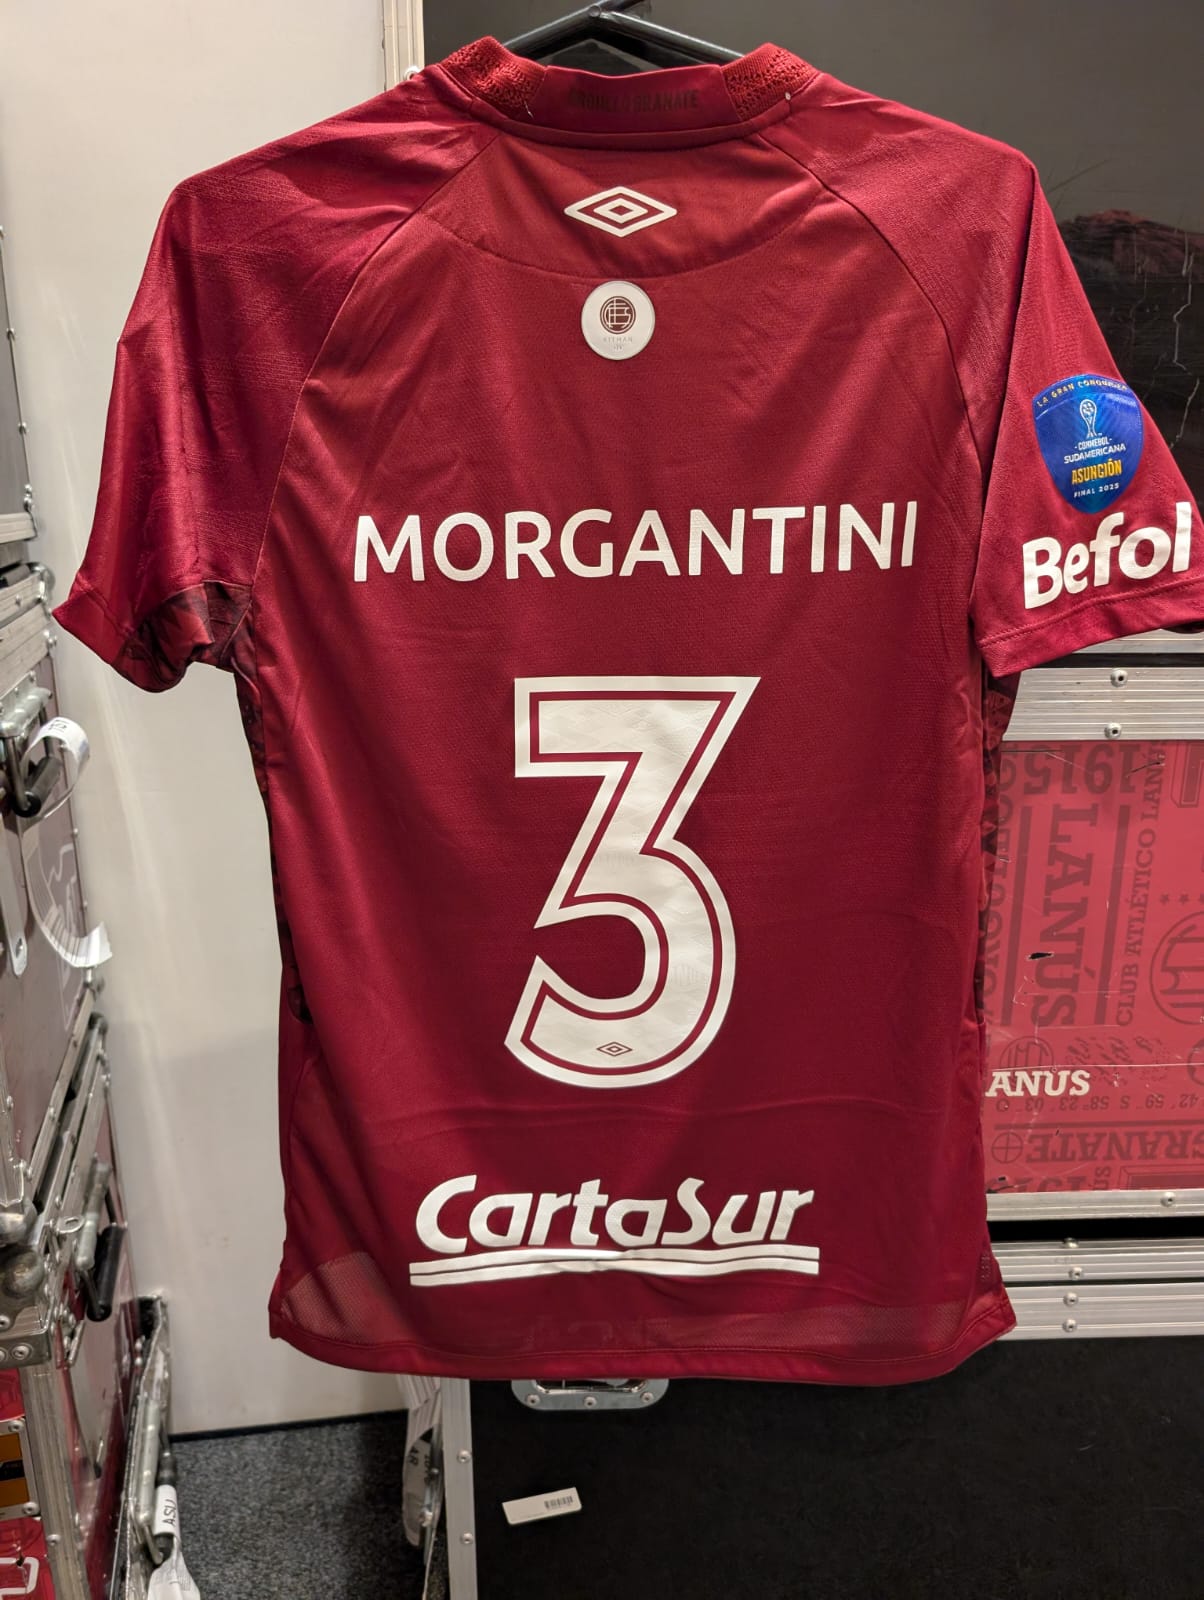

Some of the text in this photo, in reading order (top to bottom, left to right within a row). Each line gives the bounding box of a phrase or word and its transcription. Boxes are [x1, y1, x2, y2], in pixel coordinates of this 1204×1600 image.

[1036, 396, 1049, 407] LA
[1051, 383, 1075, 398] GRAN
[1063, 443, 1127, 464] SUDAMERICANA
[1071, 458, 1122, 485] ASUNCIÓN
[1073, 483, 1120, 498] FINAL 2025
[354, 501, 918, 582] MORGANTINI
[1023, 502, 1192, 610] Befol
[504, 676, 761, 1088] 3
[1031, 803, 1099, 1027] LANÚS
[1126, 828, 1156, 957] ATLÉTICO
[1116, 964, 1140, 1026] CLUB
[416, 1174, 815, 1254] CartaSur
